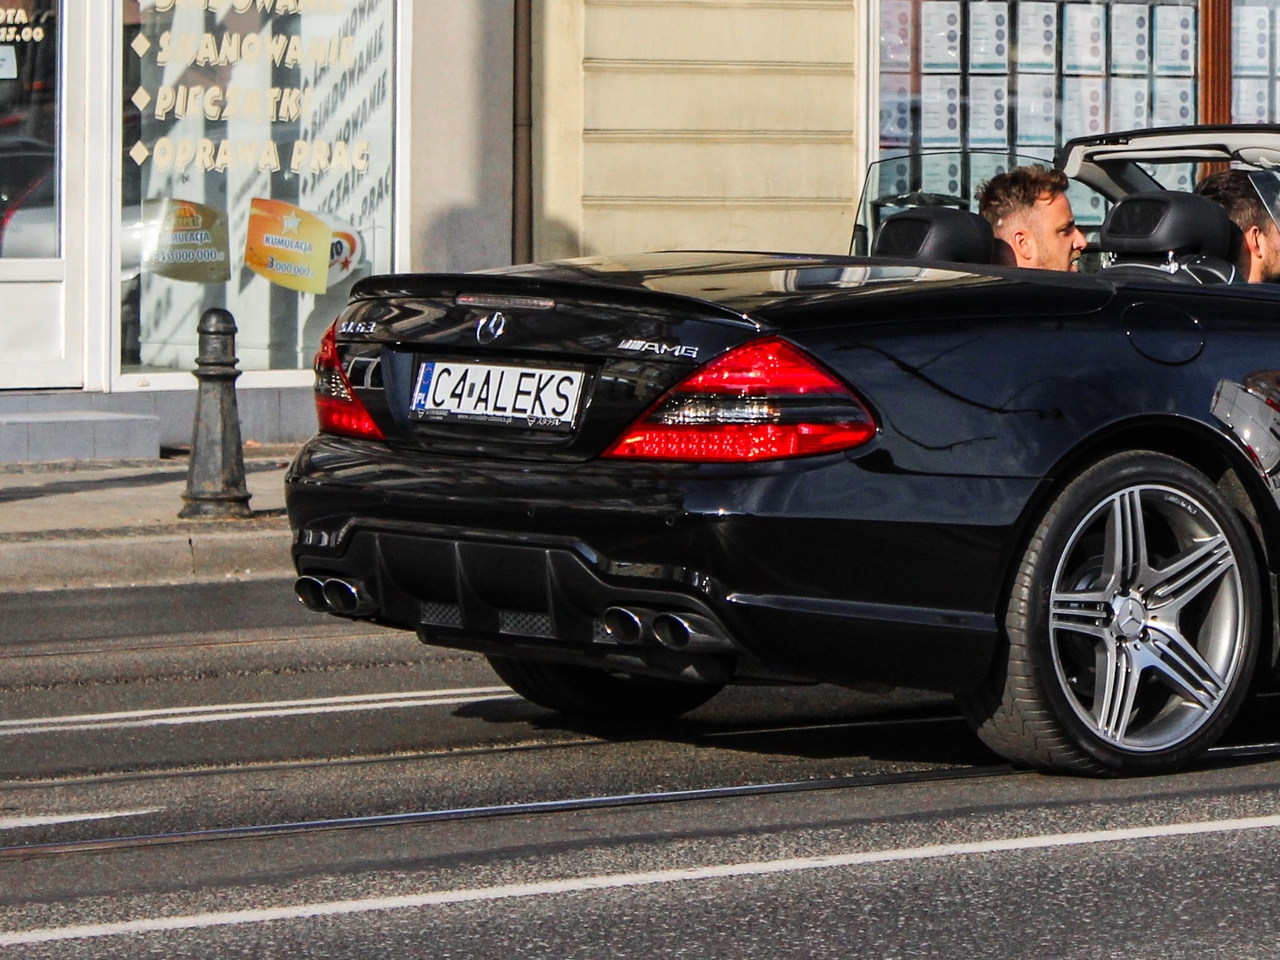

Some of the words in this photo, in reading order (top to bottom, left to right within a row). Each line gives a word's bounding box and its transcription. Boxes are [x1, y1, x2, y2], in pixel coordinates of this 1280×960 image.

[156, 31, 354, 68] SKANOWANIE
[153, 136, 281, 173] OPRAWA
[290, 139, 371, 174] PRAC
[264, 235, 313, 252] KUMULACJA
[641, 342, 699, 358] AMG
[475, 370, 574, 417] ALEKS
